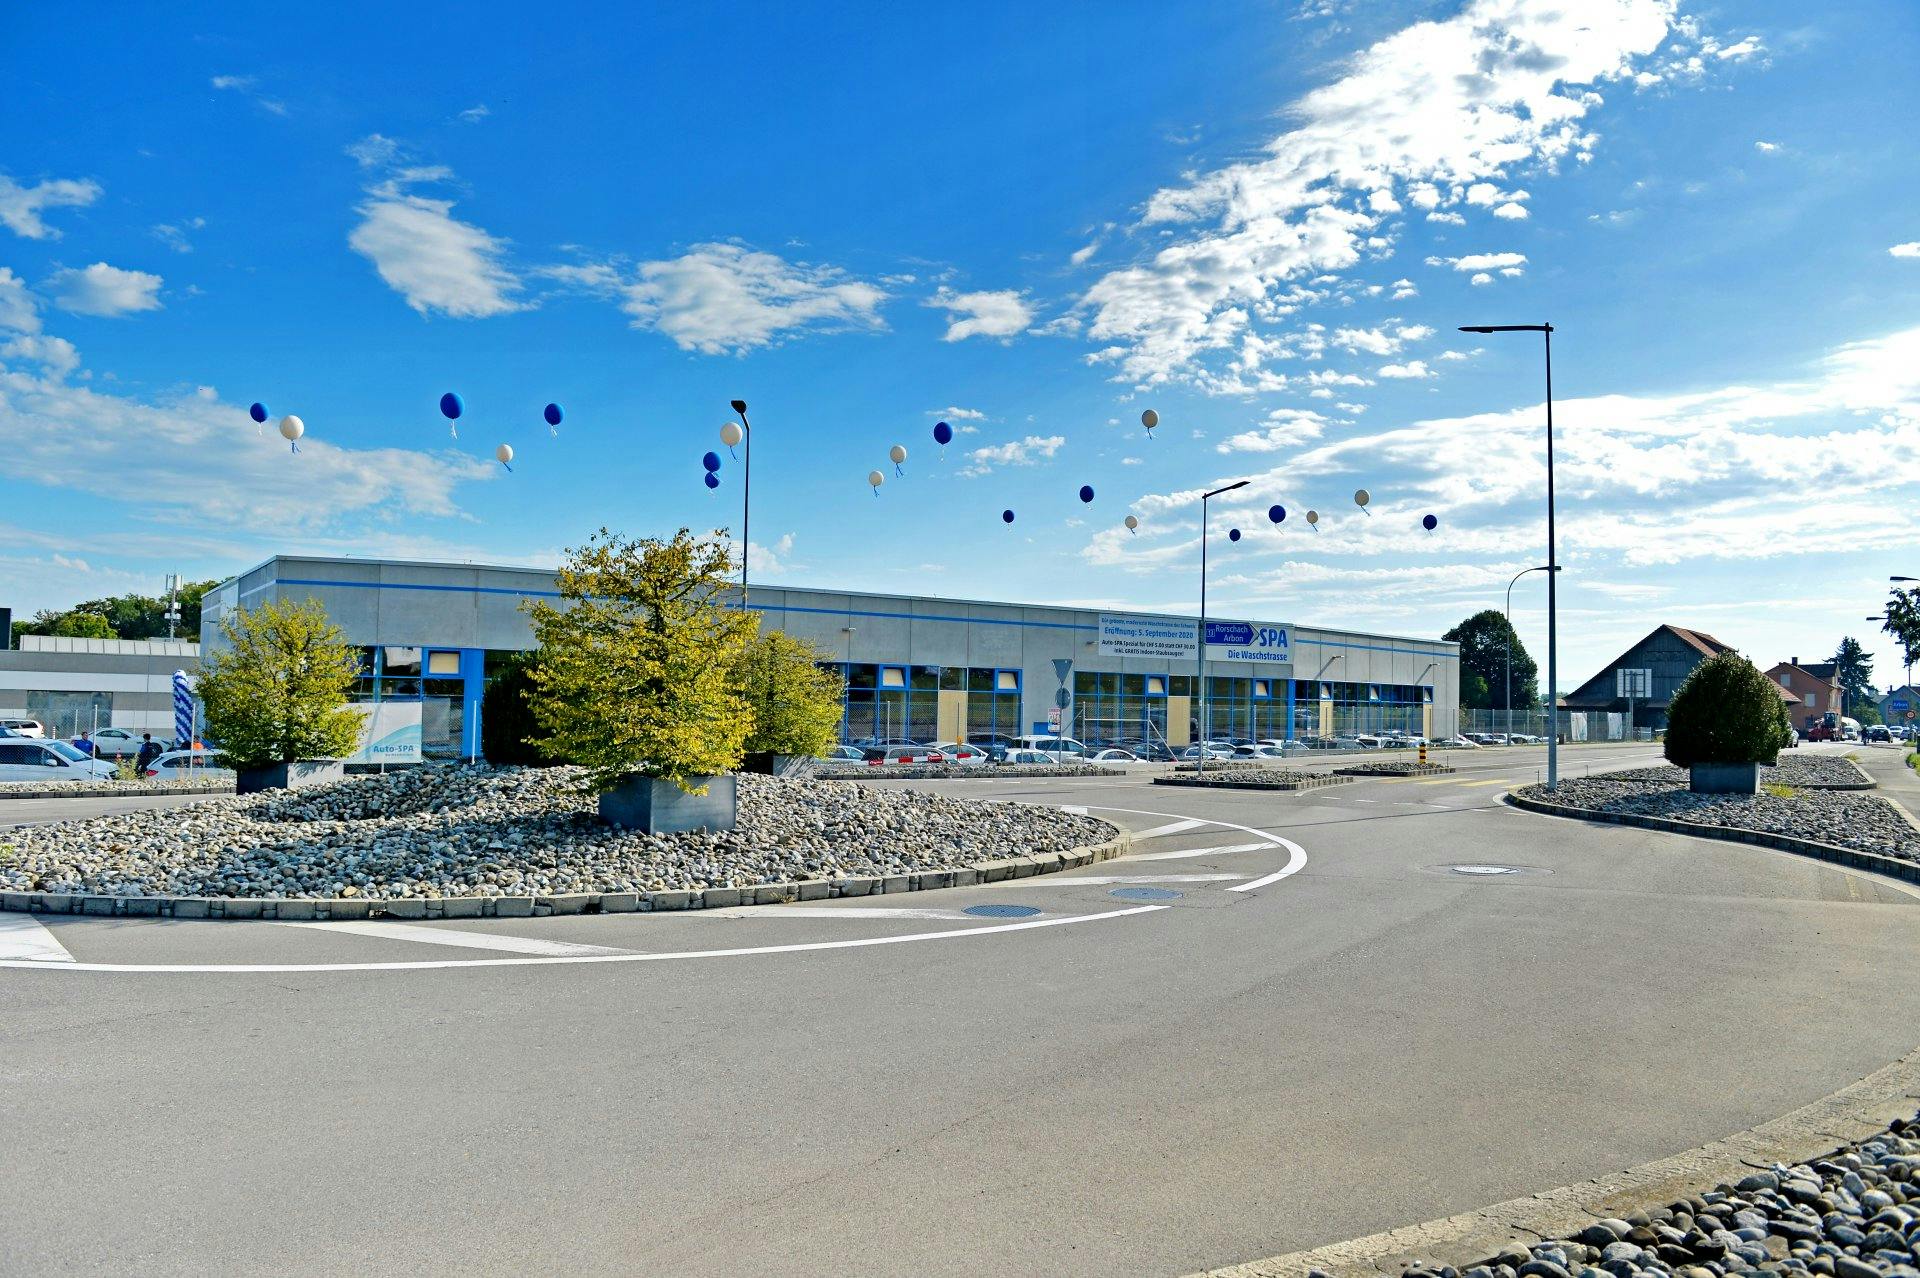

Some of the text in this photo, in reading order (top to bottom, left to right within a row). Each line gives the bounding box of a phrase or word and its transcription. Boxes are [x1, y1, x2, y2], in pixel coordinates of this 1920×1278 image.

[1104, 626, 1136, 637] Eröffnung:
[1145, 630, 1178, 638] September
[1216, 624, 1248, 632] Rorschach
[1228, 650, 1288, 661] Die Waschstrasse
